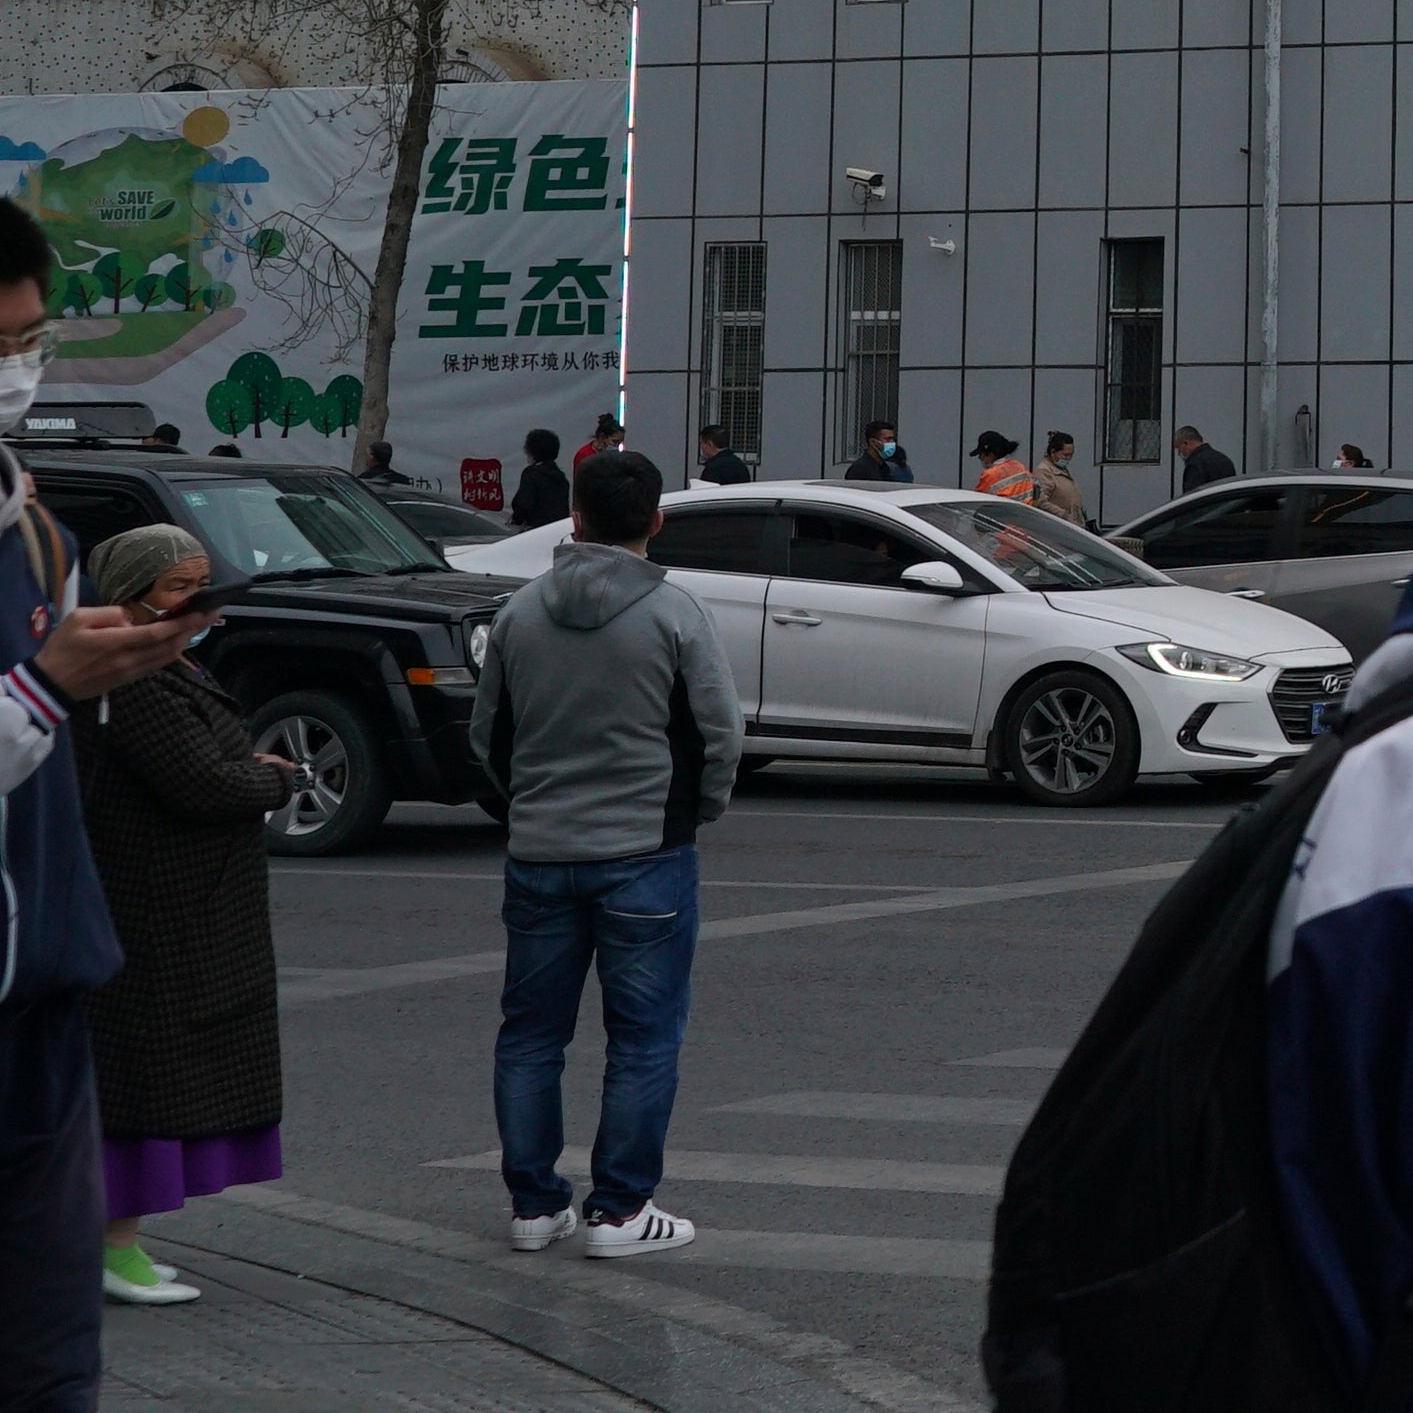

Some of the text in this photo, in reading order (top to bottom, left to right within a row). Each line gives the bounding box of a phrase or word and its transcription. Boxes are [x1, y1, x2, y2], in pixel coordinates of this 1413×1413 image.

[421, 134, 625, 215] 绿色
[118, 190, 155, 205] SAVE
[100, 206, 147, 220] world
[418, 258, 622, 338] 生态
[442, 351, 619, 372] 保护地球环境从你我
[25, 418, 76, 429] YAKIMA
